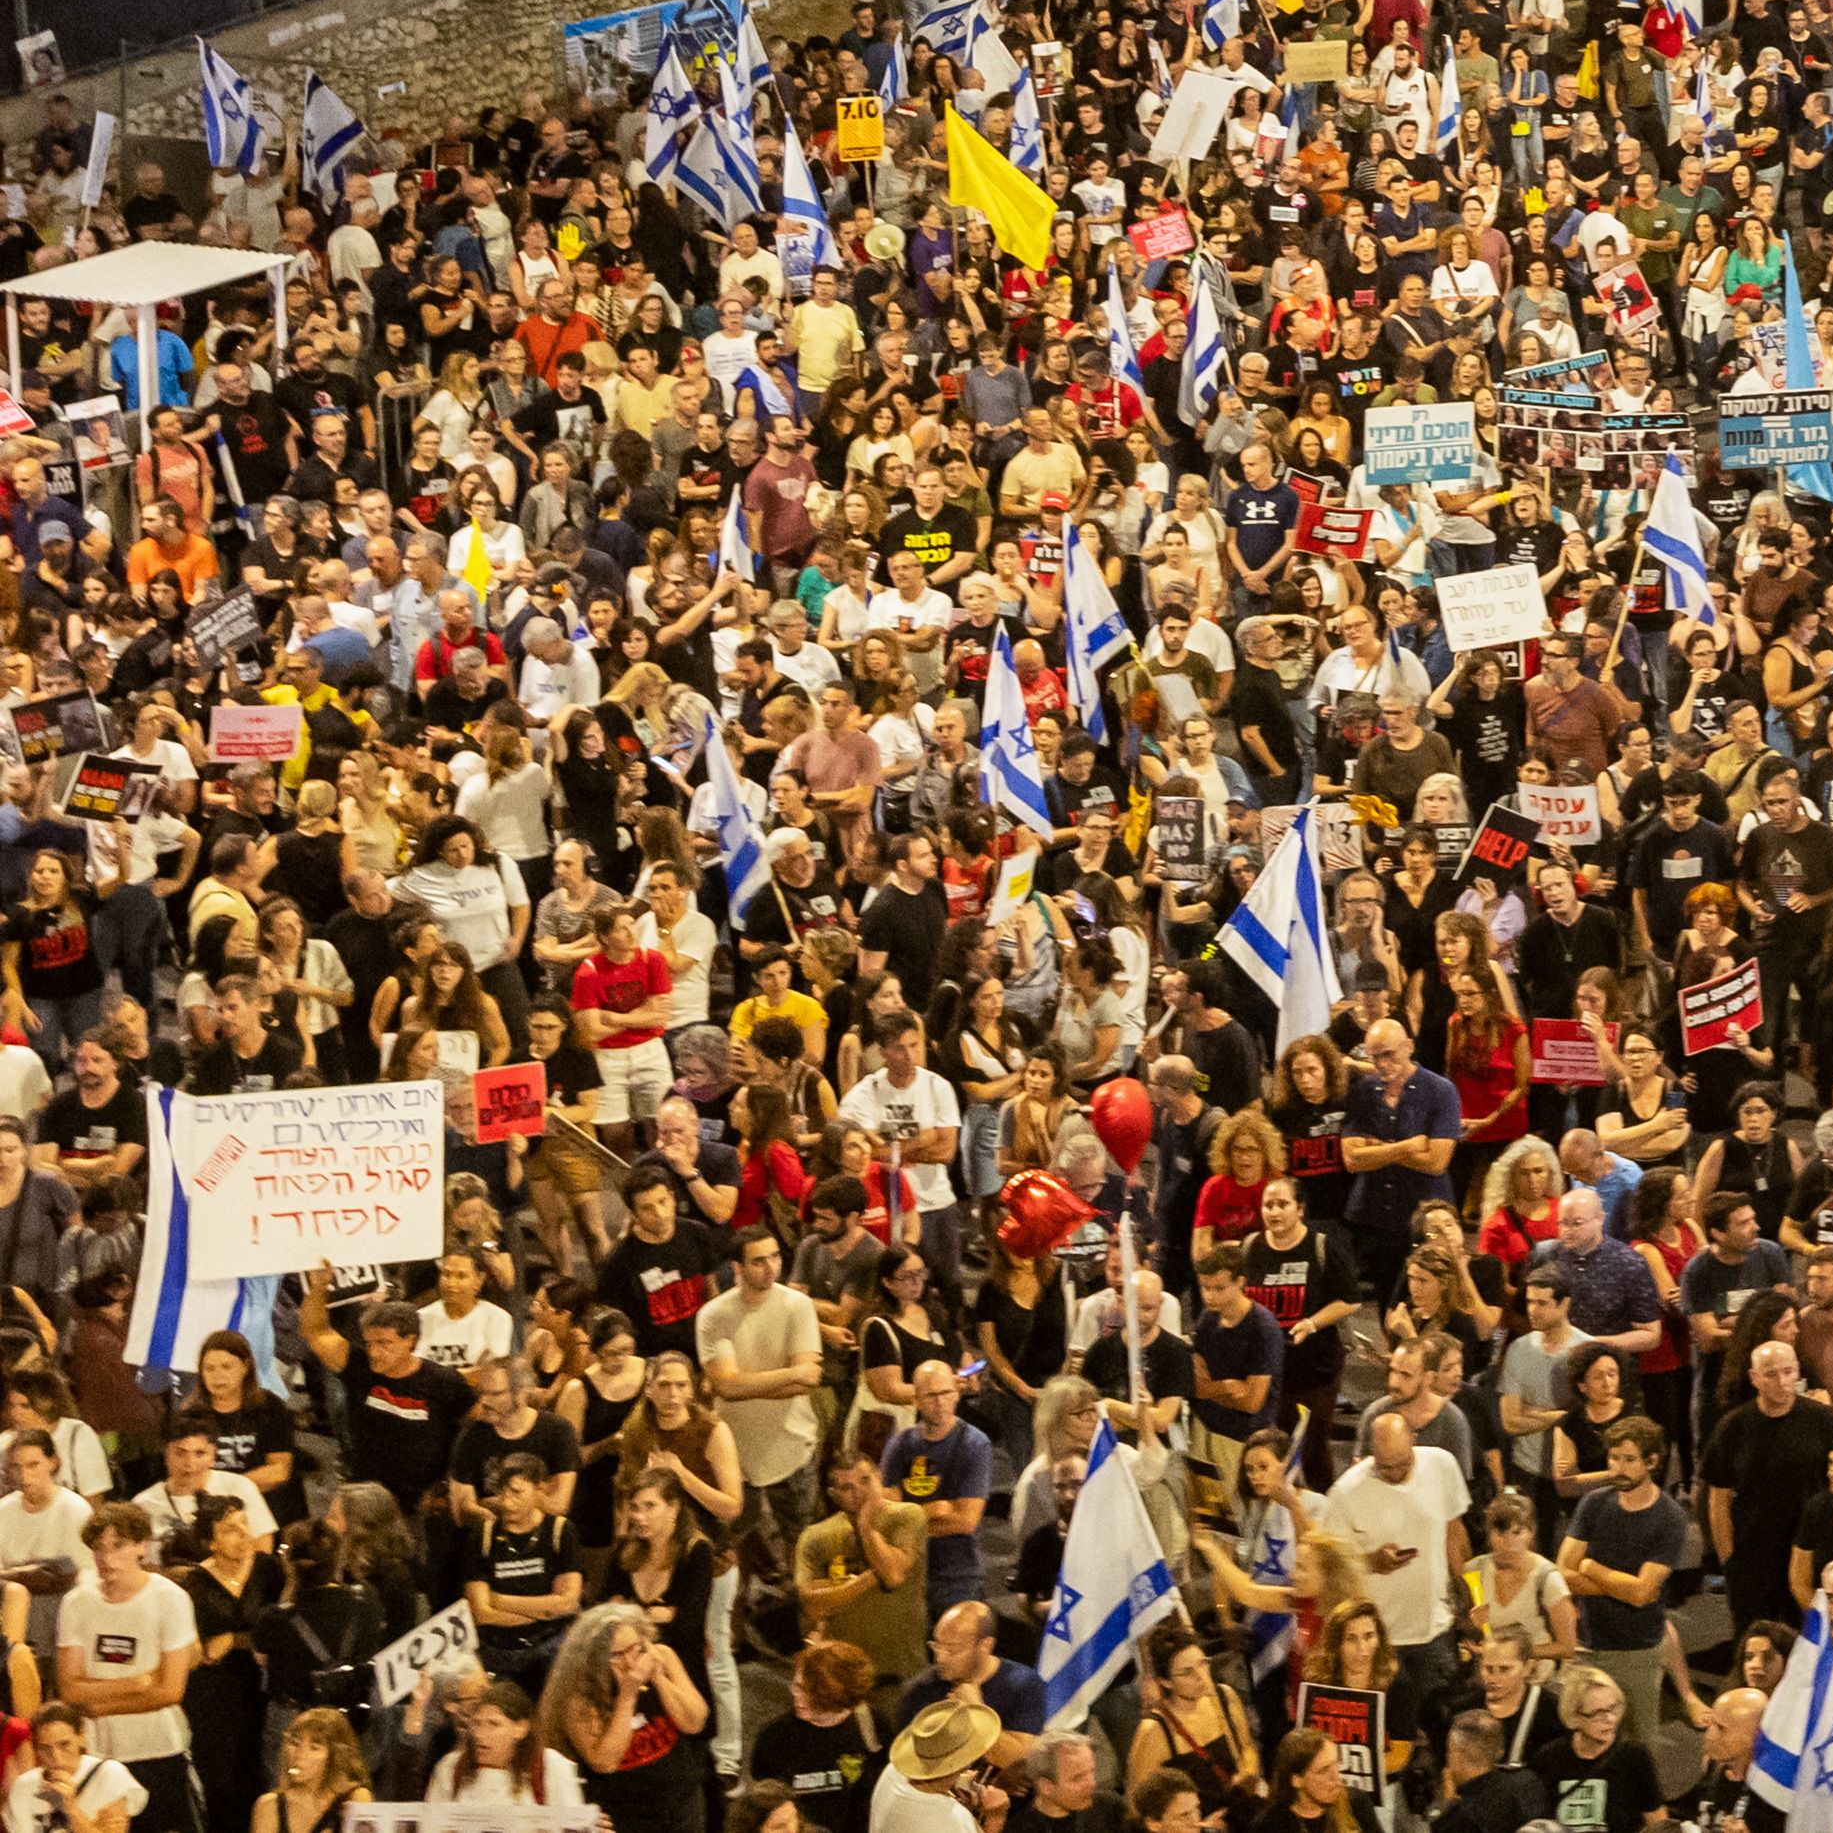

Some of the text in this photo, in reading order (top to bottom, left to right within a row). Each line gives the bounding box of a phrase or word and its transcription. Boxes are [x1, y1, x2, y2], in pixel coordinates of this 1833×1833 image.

[841, 100, 880, 120] 7.10
[1338, 367, 1381, 383] VOTE
[1342, 381, 1381, 397] NOW
[1412, 409, 1428, 423] רק
[1721, 394, 1831, 418] סירוב לעסקה
[1369, 421, 1470, 444] הסכם מדיני
[1769, 428, 1794, 449] דין
[1800, 425, 1829, 443] גזר
[1367, 446, 1471, 474] יביא ביטחון
[1750, 445, 1830, 464] לחטופים!
[1157, 801, 1197, 819] WAR
[1158, 823, 1196, 843] HAS
[1472, 826, 1529, 870] HELP
[403, 1085, 439, 1108] אם
